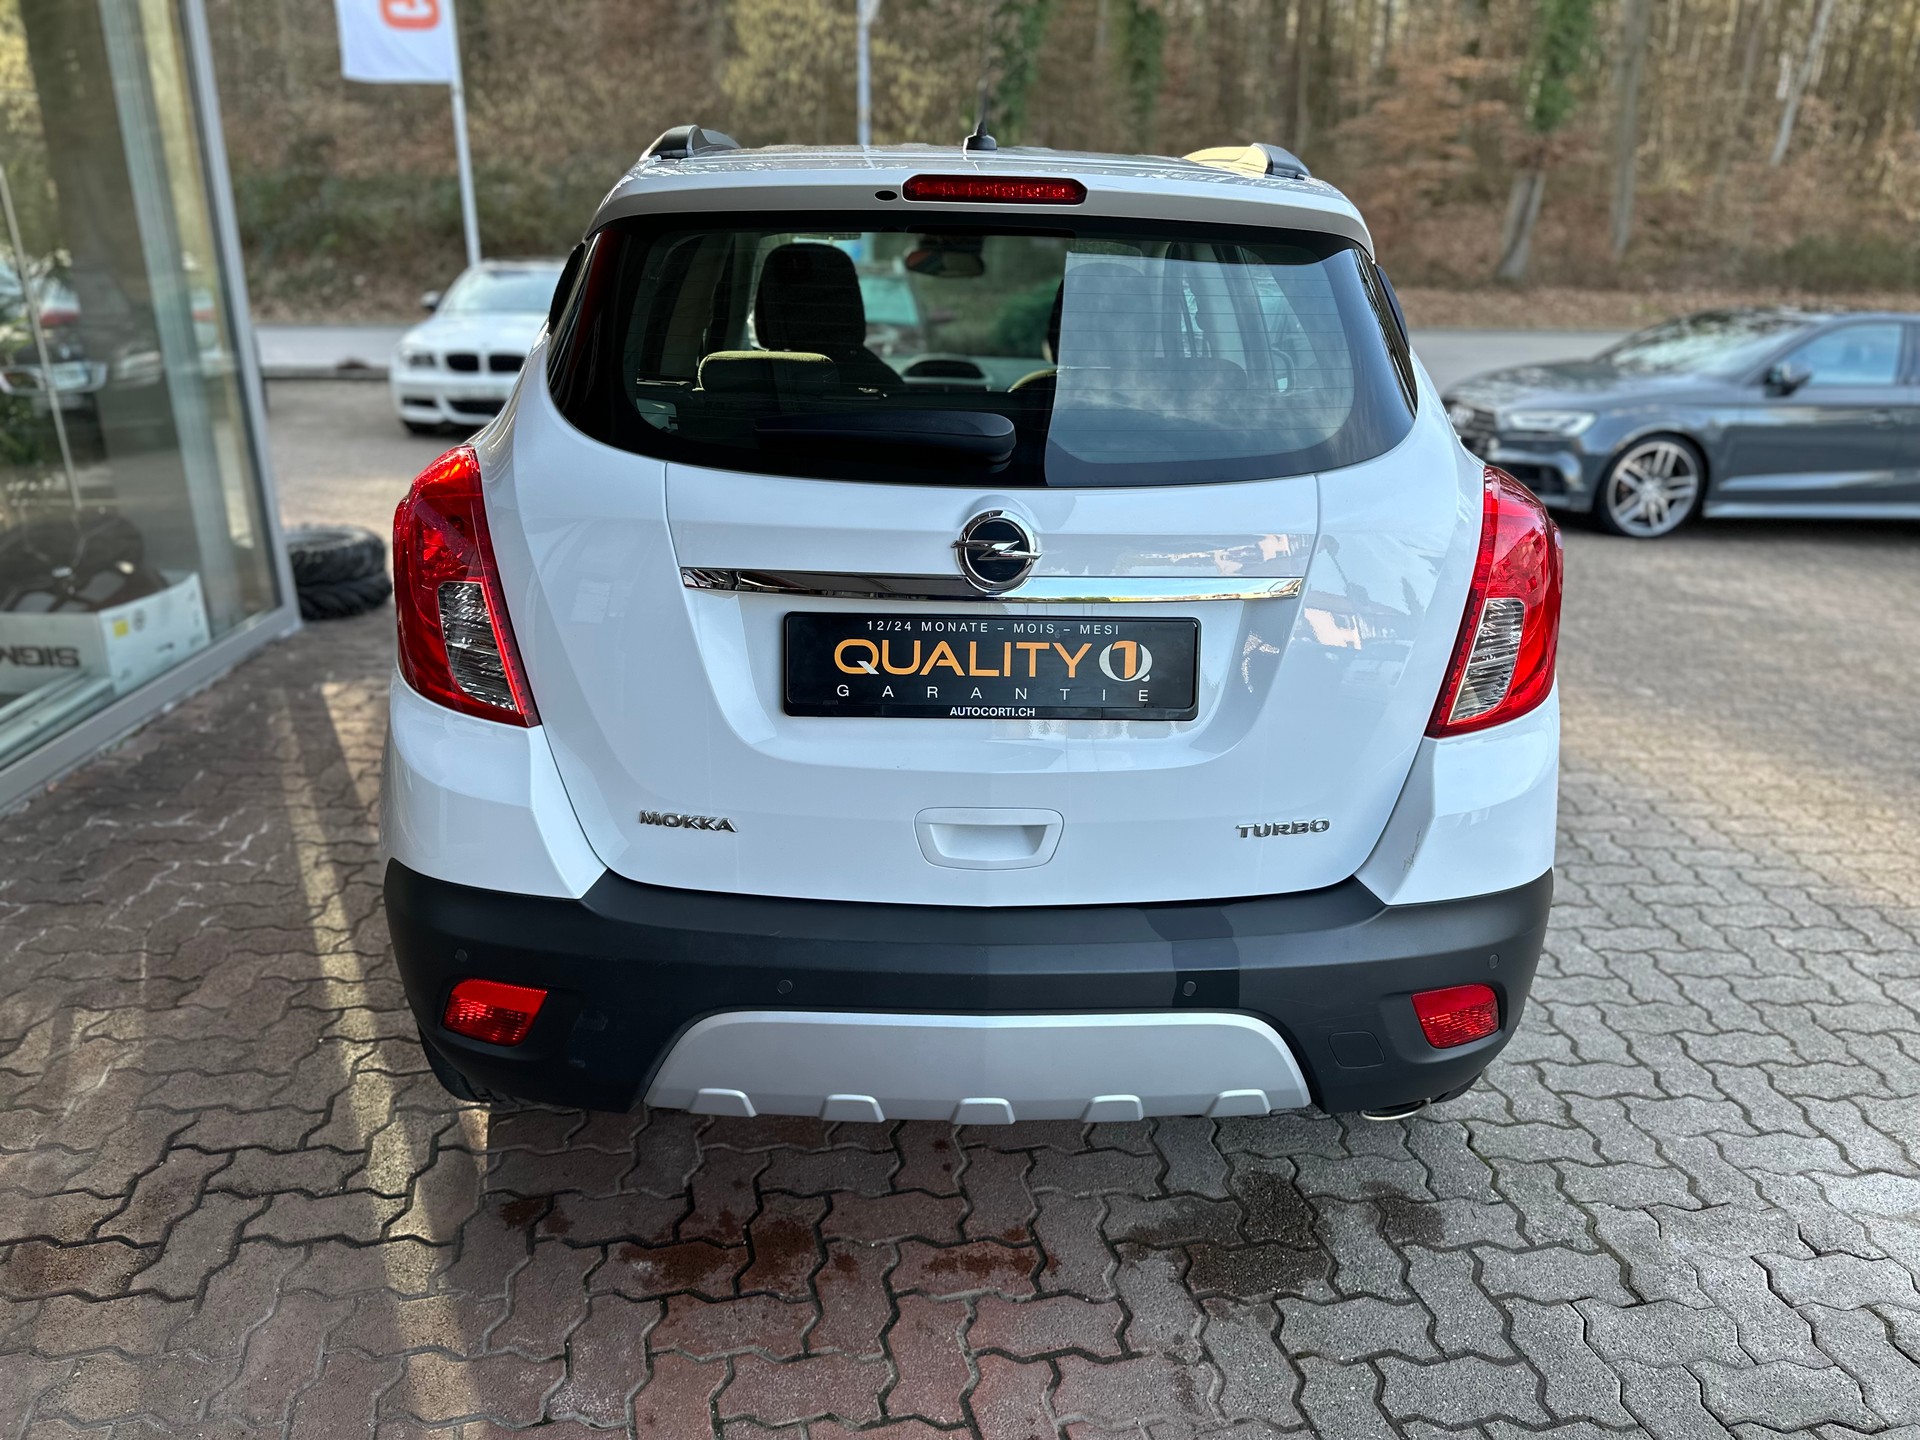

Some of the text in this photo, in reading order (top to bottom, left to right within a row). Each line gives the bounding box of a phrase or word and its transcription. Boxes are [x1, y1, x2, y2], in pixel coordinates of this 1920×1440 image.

[867, 620, 912, 631] 12/24
[921, 621, 988, 633] MONATE
[1013, 623, 1054, 634] MOIS
[1079, 624, 1119, 635] MESI
[834, 638, 1093, 679] QUALITY
[949, 707, 1036, 717] AUTOCORTI.CH
[639, 809, 738, 833] MOKKA
[1235, 818, 1330, 838] TURBO
